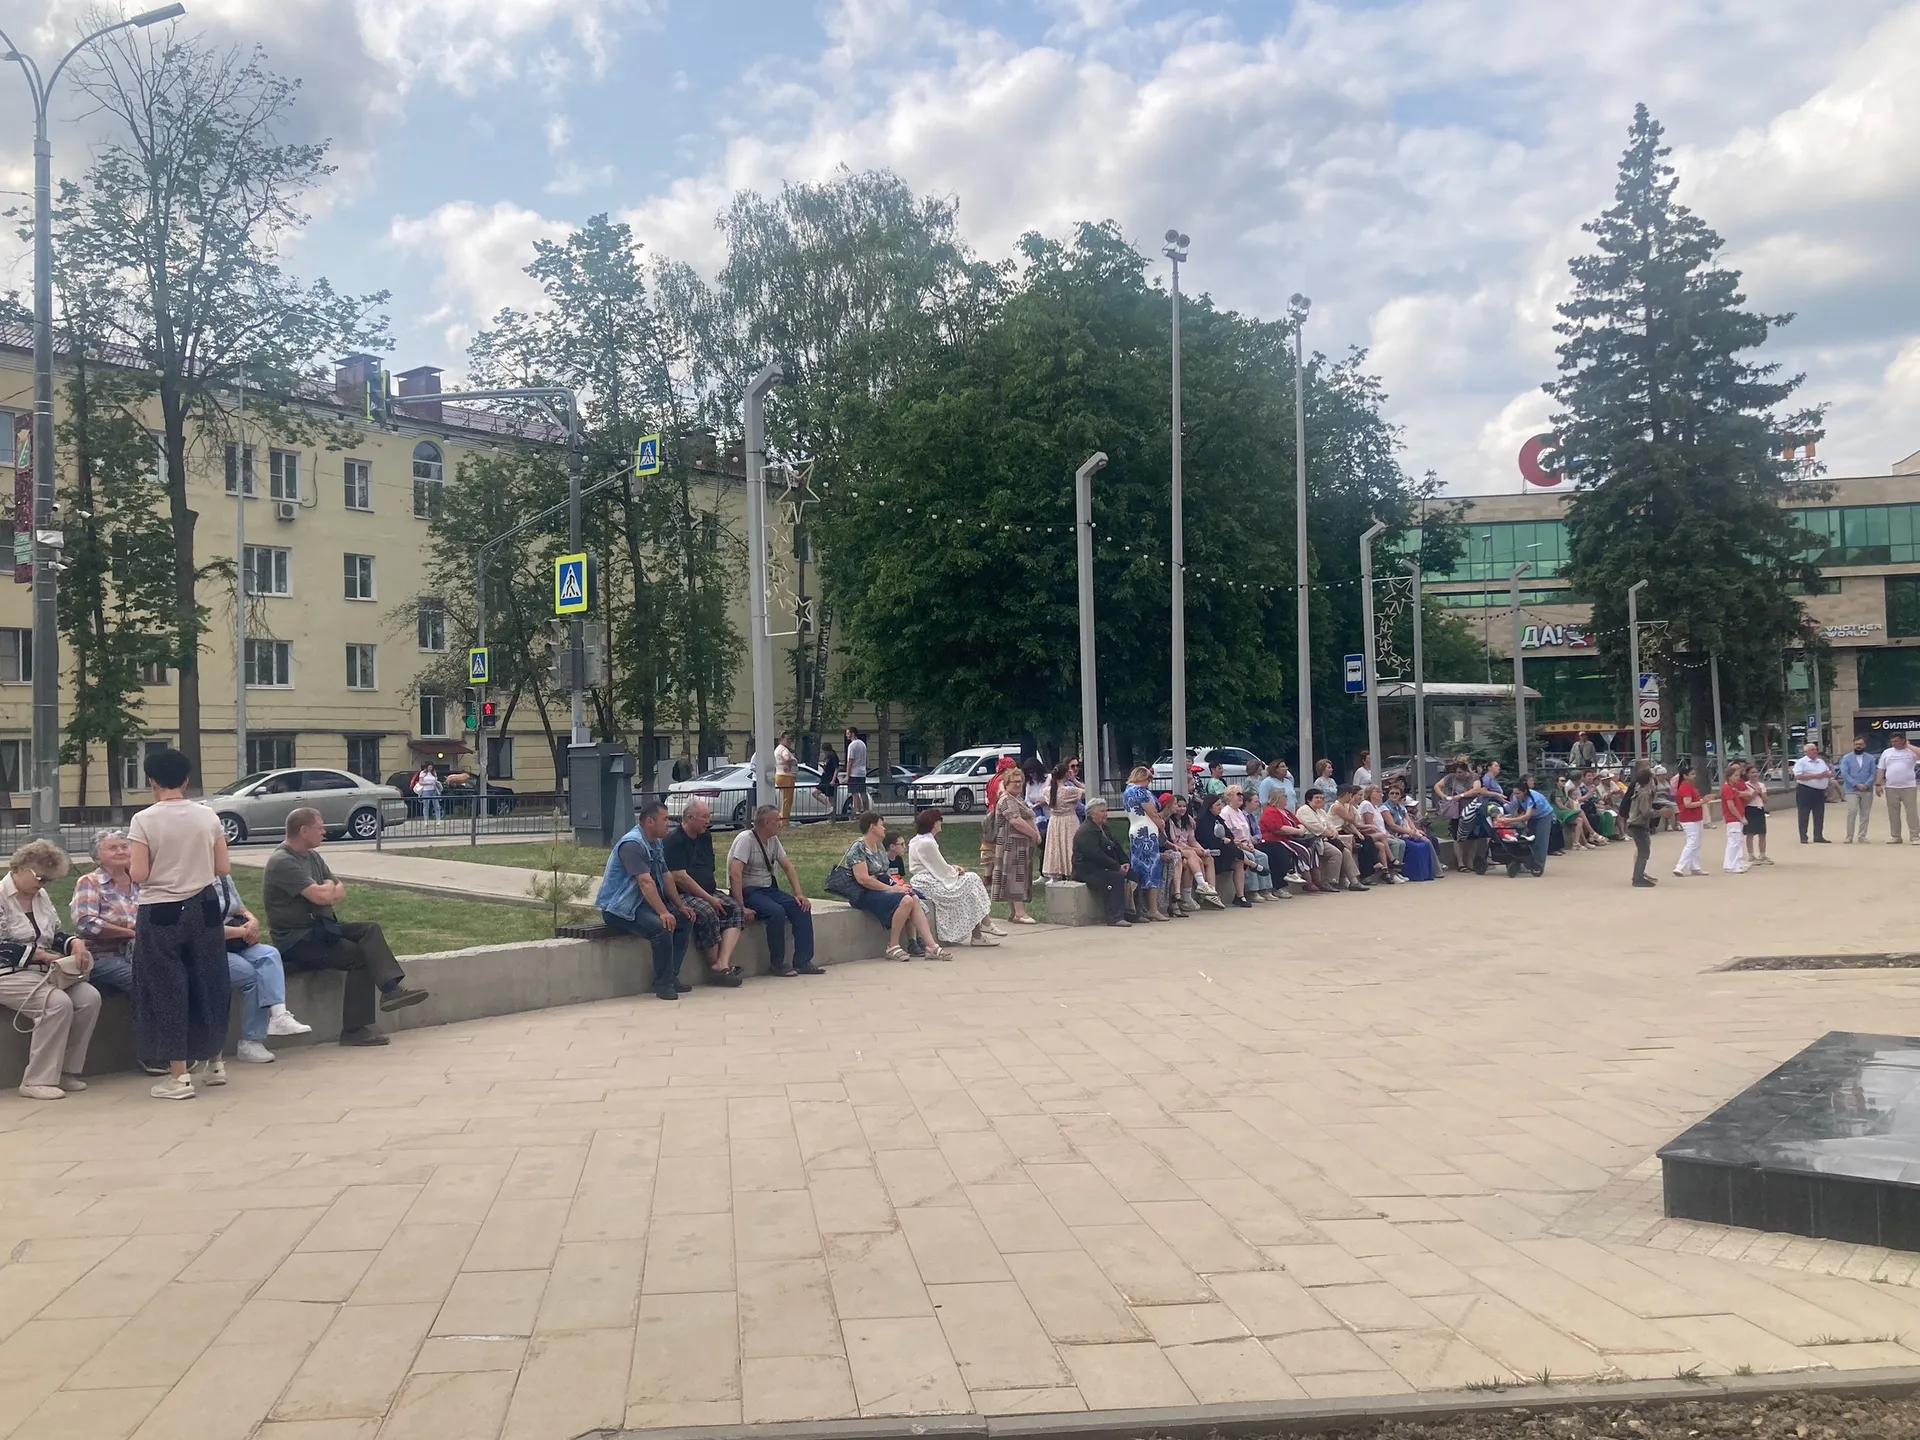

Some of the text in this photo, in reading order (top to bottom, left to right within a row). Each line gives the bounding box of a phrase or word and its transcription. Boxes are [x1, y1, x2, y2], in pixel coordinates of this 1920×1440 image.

[1521, 624, 1563, 648] ДА!
[1643, 708, 1658, 718] 20
[1882, 720, 1920, 730] билайн
